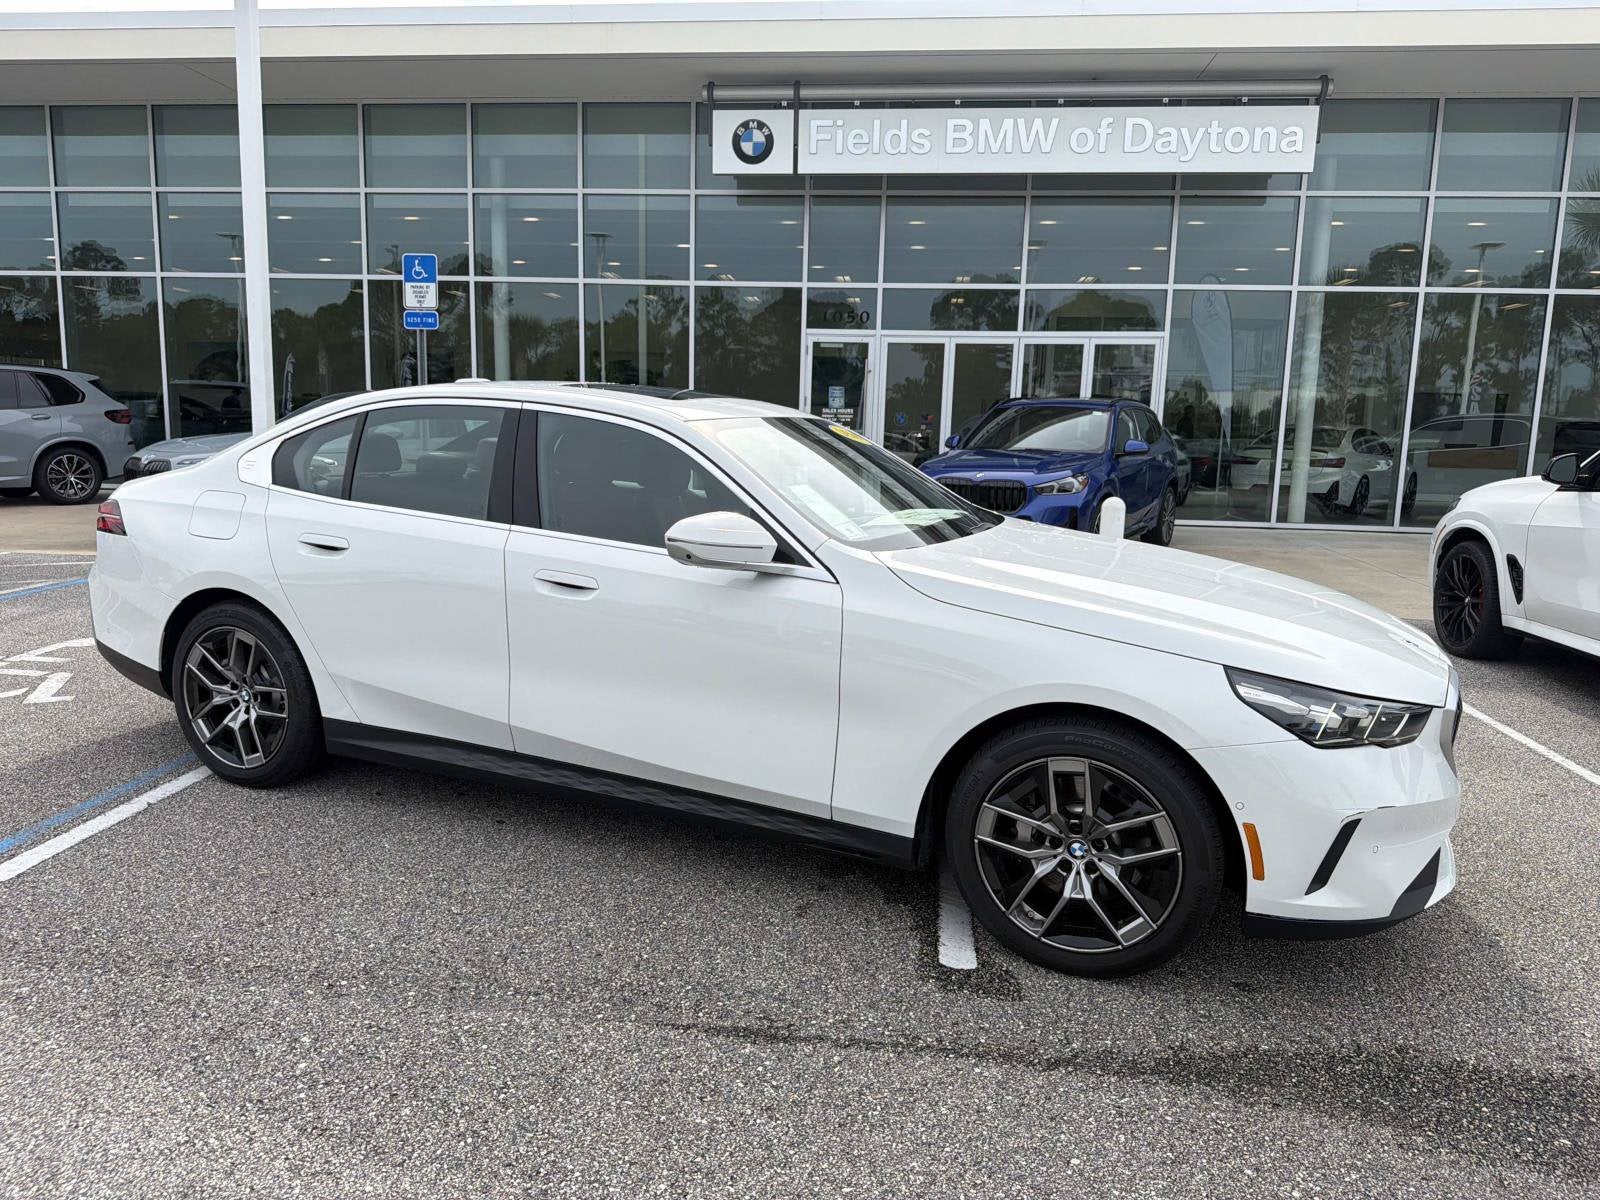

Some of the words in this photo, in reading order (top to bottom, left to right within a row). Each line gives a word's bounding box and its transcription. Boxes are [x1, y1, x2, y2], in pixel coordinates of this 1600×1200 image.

[736, 120, 771, 136] BMW
[808, 118, 933, 156] Fields
[944, 117, 1059, 155] BMW
[1068, 117, 1113, 154] of
[1122, 117, 1305, 162] Daytona
[822, 310, 869, 324] 1050
